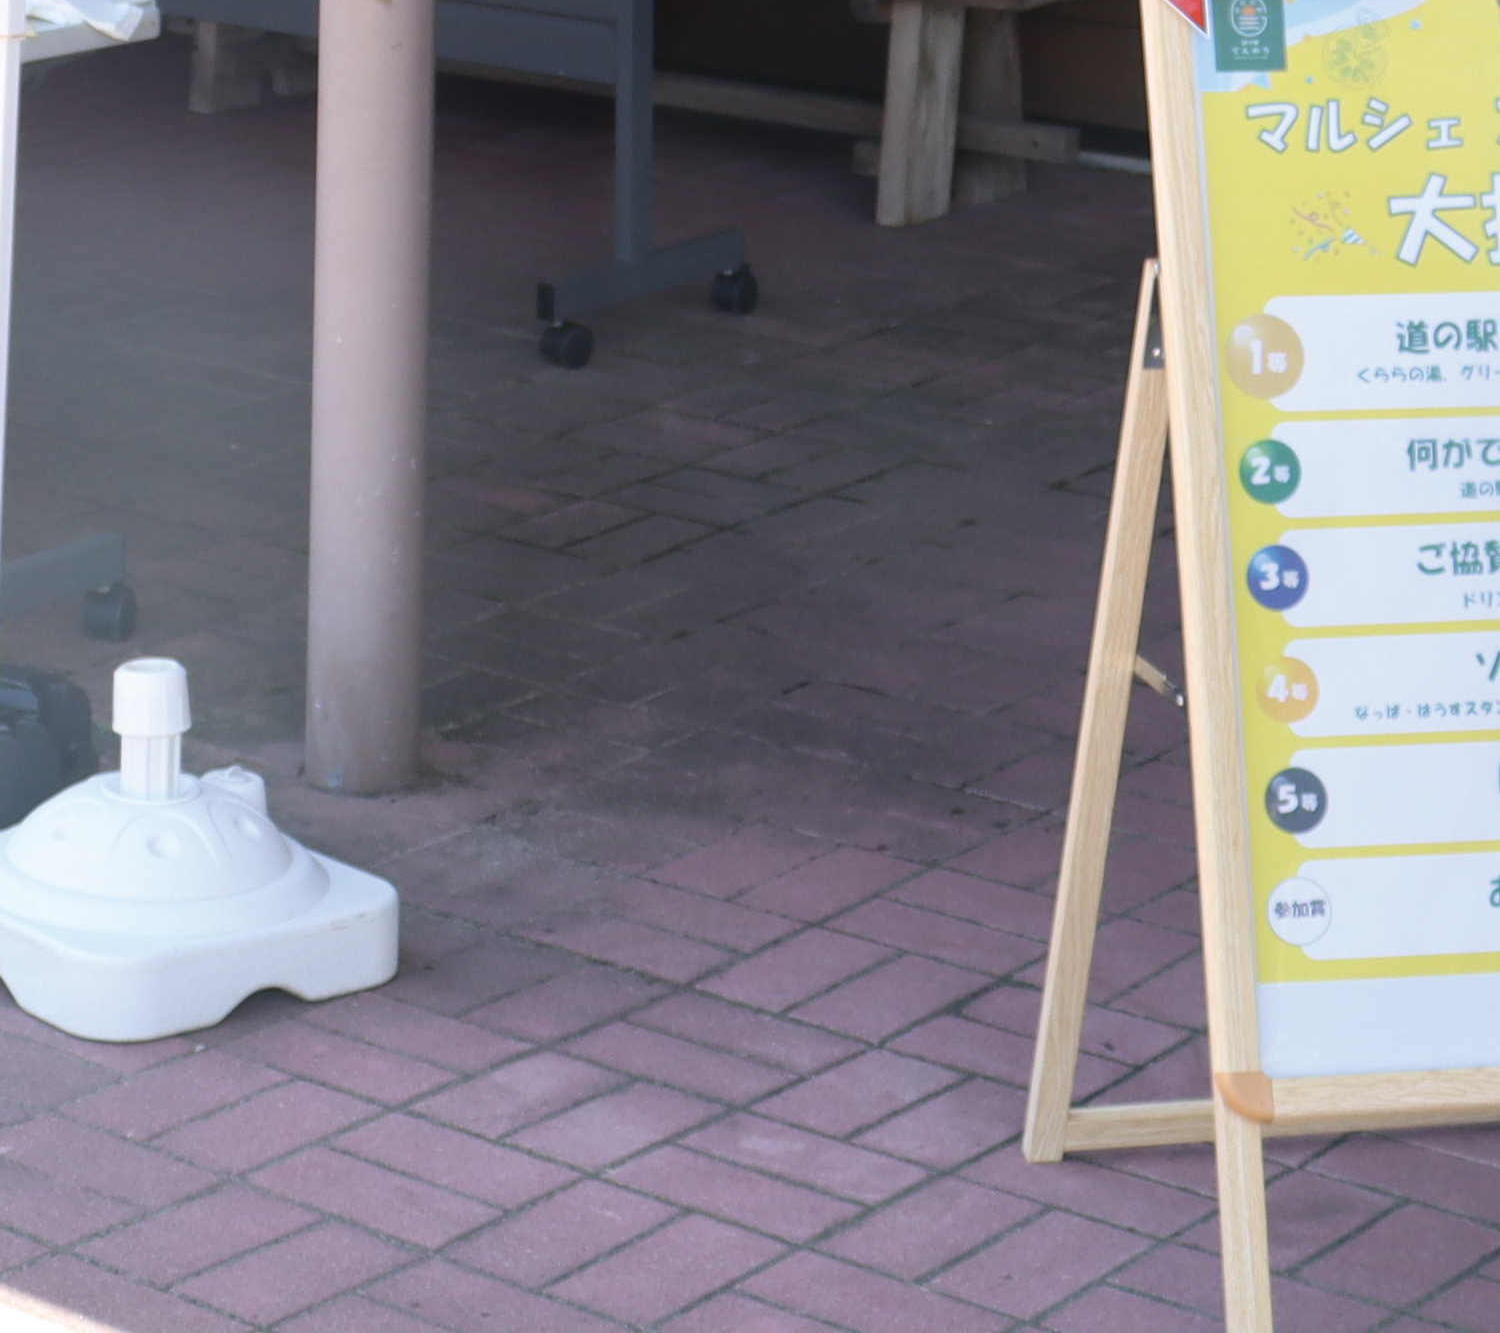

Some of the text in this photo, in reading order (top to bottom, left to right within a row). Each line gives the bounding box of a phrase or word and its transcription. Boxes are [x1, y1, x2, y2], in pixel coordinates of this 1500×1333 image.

[1246, 96, 1464, 154] マルシェ
[1250, 339, 1288, 374] 1等
[1249, 457, 1291, 485] 2等
[1257, 561, 1300, 592] 3等
[1265, 675, 1308, 702] 4等
[1277, 784, 1319, 815] 5等
[1273, 898, 1328, 921] 参加賞
